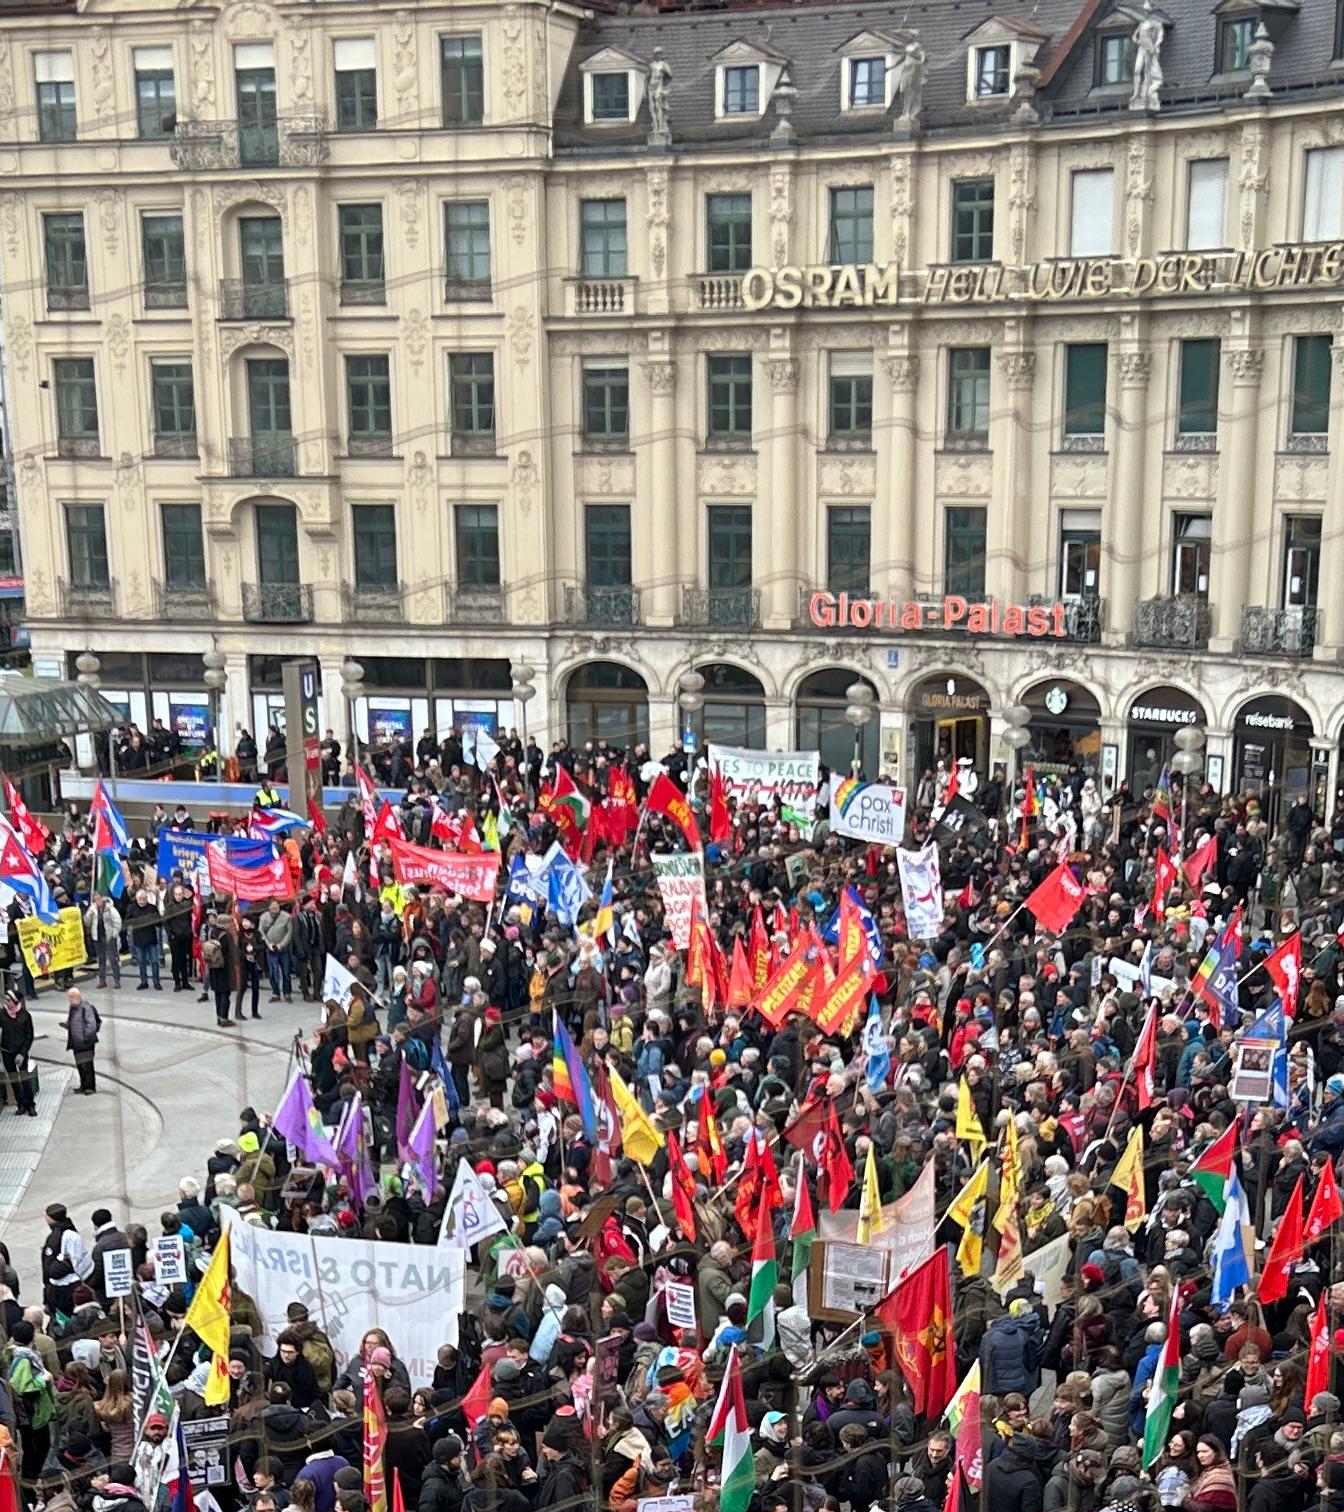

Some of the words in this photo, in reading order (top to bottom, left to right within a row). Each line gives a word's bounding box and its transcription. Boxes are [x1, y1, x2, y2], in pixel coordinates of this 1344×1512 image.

[742, 261, 900, 310] OSRAM
[924, 263, 1005, 304] HELL
[1030, 259, 1112, 299] WIE
[1130, 252, 1209, 294] DER
[808, 591, 1067, 638] Gloria-Palast
[302, 672, 314, 699] U
[921, 693, 952, 710] GLORIA
[953, 694, 980, 711] PALAST
[305, 707, 317, 733] S
[1131, 706, 1196, 725] STARBUCKS
[1245, 712, 1294, 731] reisebank
[768, 765, 813, 778] PEACE
[860, 795, 892, 817] pax
[847, 811, 894, 835] christi
